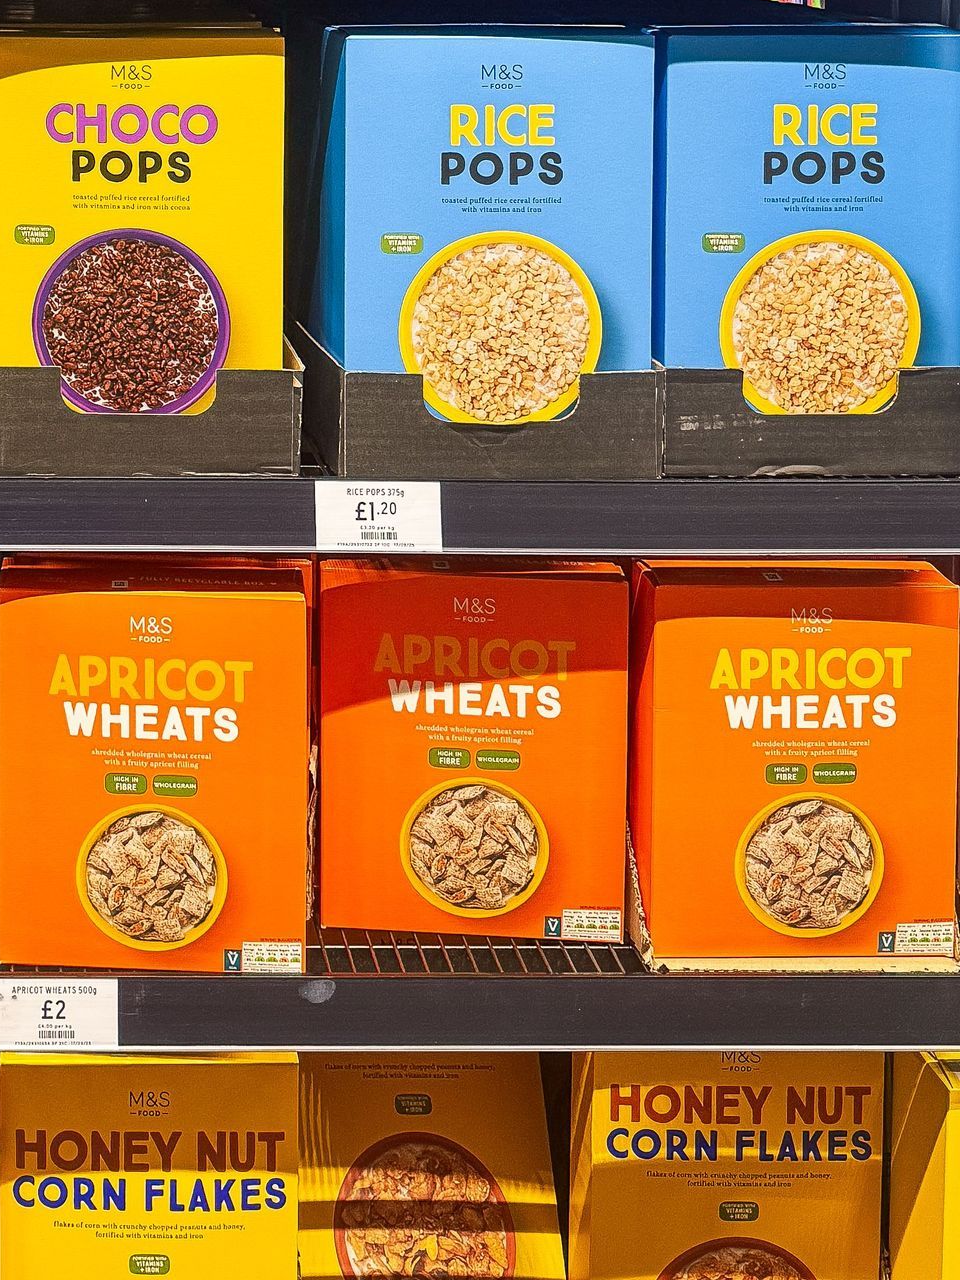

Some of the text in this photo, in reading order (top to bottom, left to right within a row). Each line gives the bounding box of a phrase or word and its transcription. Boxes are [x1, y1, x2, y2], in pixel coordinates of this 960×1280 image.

[110, 65, 152, 81] M&S
[45, 104, 219, 144] CHOCO
[450, 104, 556, 146] RICE
[71, 150, 192, 183] POPS
[441, 152, 564, 186] POPS
[441, 196, 562, 205] toasted puffed rice cereal fortified
[346, 488, 405, 497] RICE POPS 375g
[355, 501, 397, 521] £1.20
[374, 633, 576, 681] APRICOT
[709, 647, 912, 690] APRICOT
[48, 653, 254, 703] APRICOT
[388, 679, 562, 718] WHEATS
[724, 694, 897, 729] WHEATS
[63, 701, 240, 742] WHEATS
[12, 986, 97, 996] APRICOT WHEATS 500g
[41, 999, 66, 1020] £2
[609, 1084, 872, 1125] HONEY NUT
[15, 1129, 286, 1173] HONEY NUT
[606, 1128, 872, 1162] CORN FLAKES
[12, 1175, 287, 1212] CORN FLAKES
